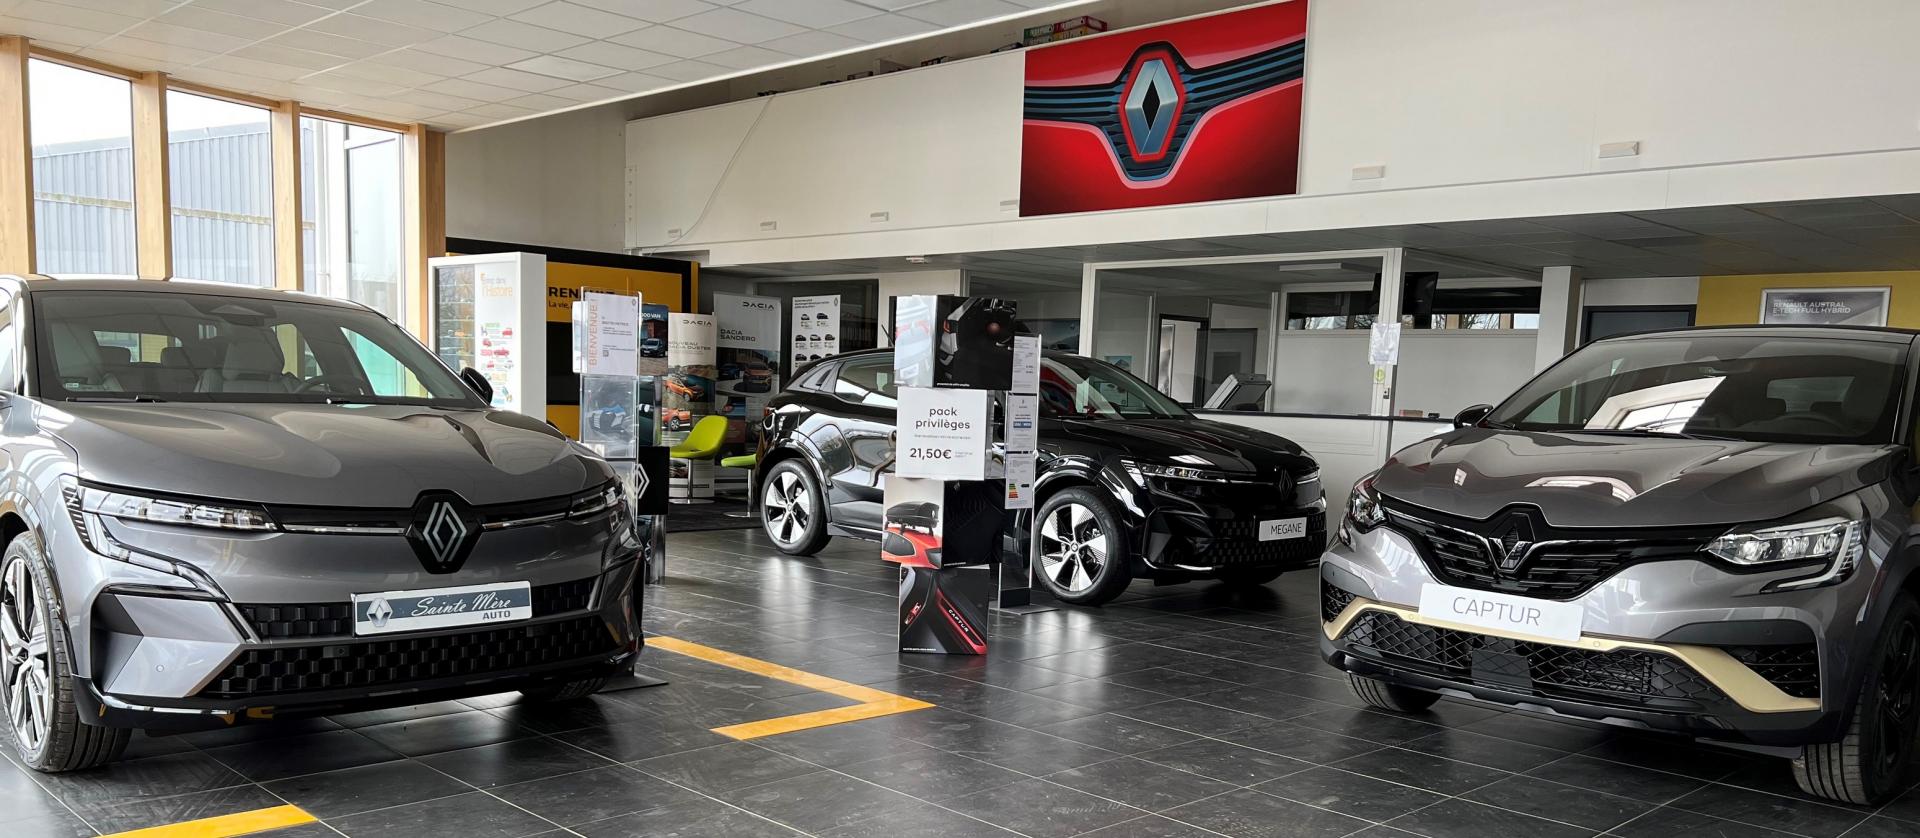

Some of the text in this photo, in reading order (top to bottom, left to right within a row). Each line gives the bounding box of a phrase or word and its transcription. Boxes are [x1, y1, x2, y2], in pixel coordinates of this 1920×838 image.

[742, 301, 775, 310] DACIA
[589, 304, 598, 366] BIENVENUE
[720, 334, 756, 342] SANDERO
[929, 407, 958, 417] pack
[915, 418, 970, 431] privilèges
[909, 447, 952, 461] 21,50€
[1270, 522, 1303, 535] MEGANE
[411, 591, 511, 616] Sainte Mère
[482, 610, 511, 620] AUTO
[1452, 596, 1541, 626] CAPTUR
[948, 609, 969, 632] CAPTUR
